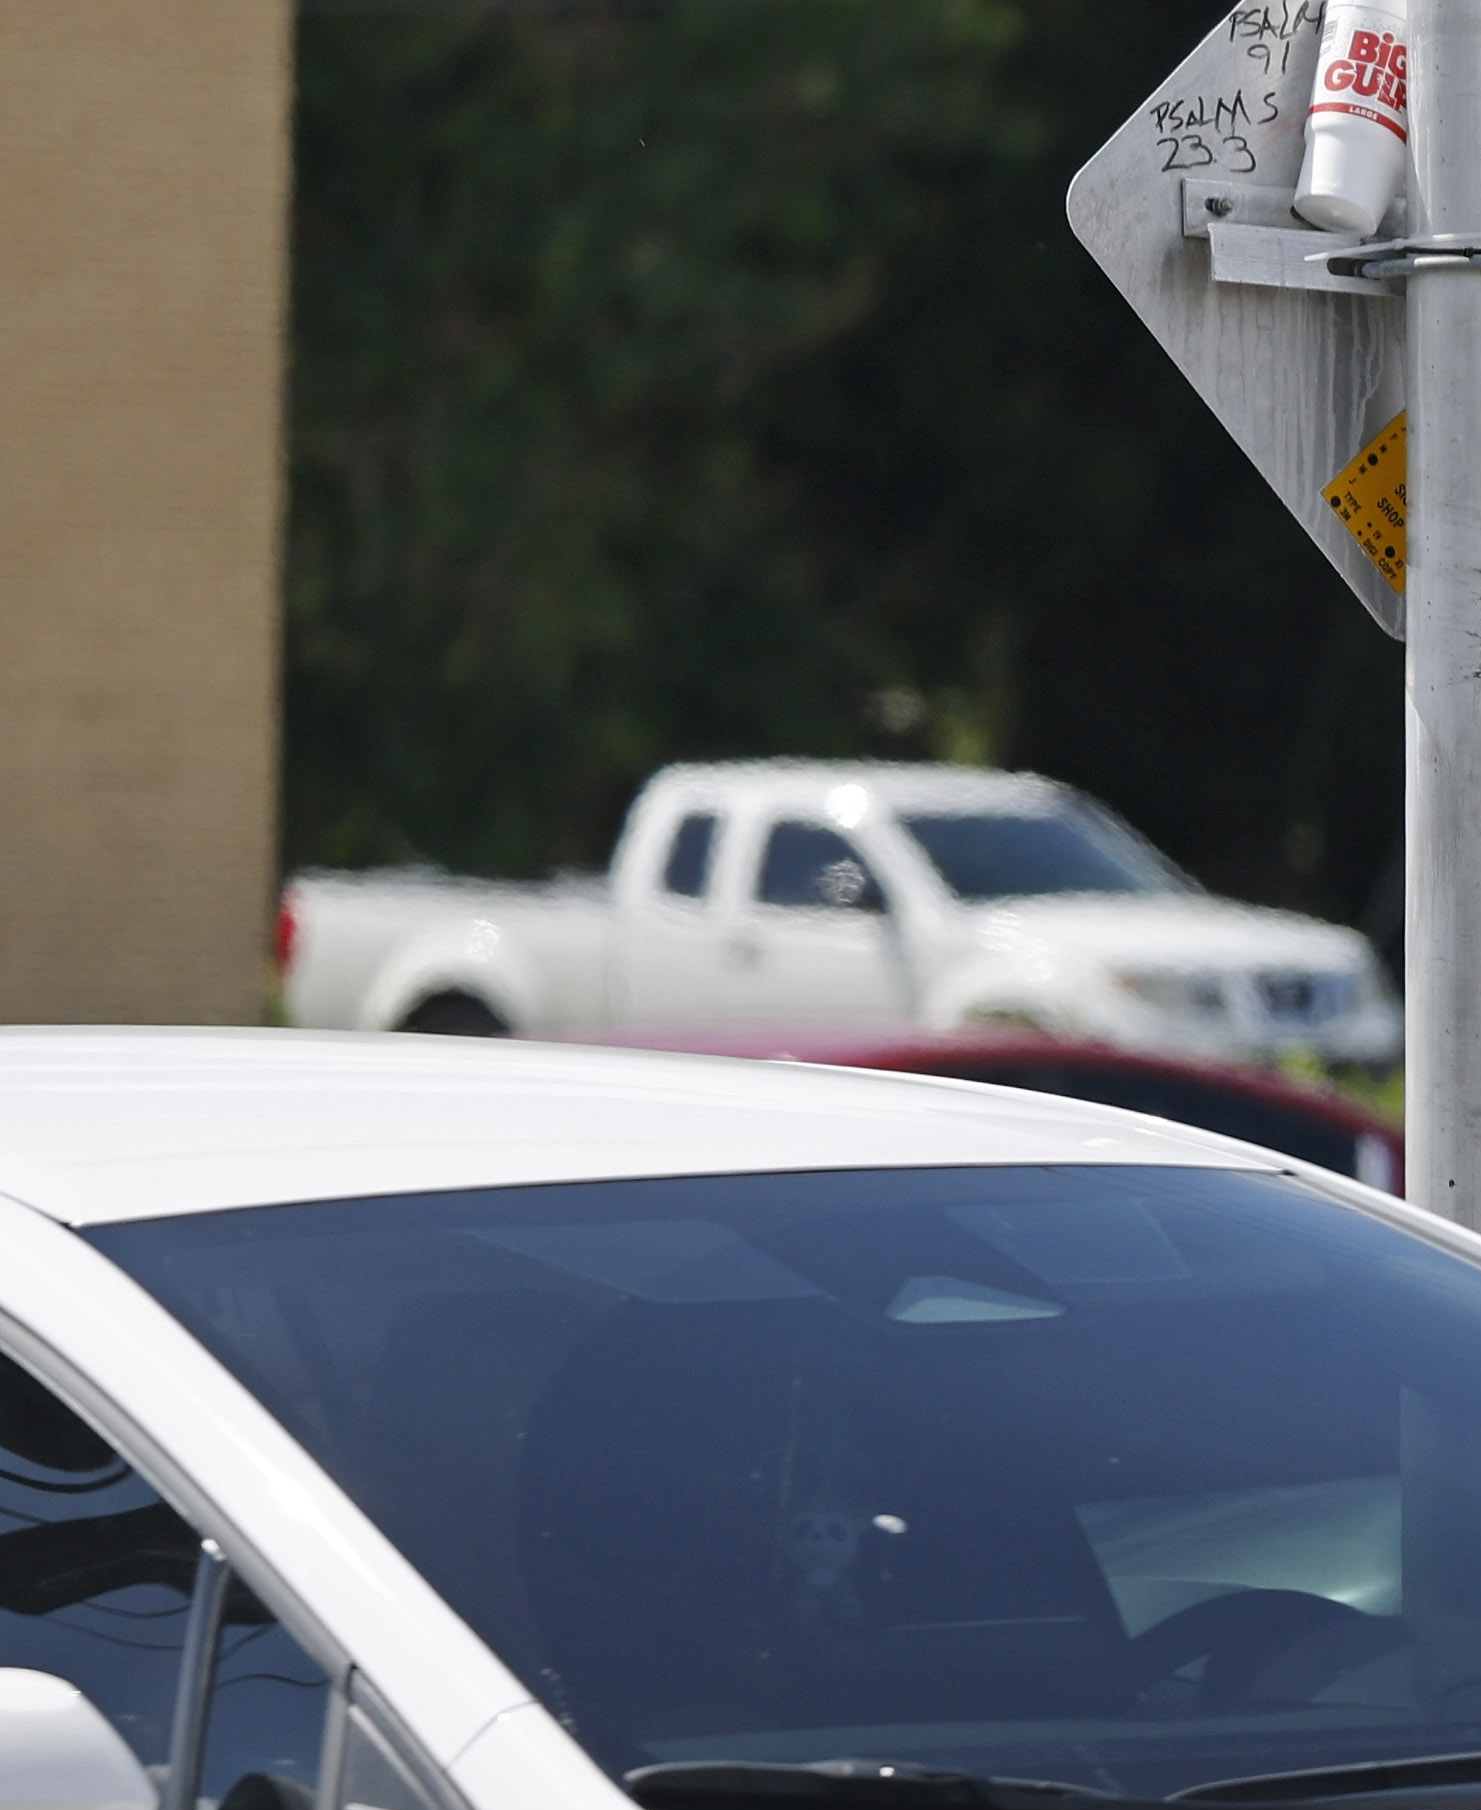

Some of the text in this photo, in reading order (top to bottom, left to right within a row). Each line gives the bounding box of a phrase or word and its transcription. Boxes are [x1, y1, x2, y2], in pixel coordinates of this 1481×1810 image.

[1246, 41, 1290, 75] 91
[1349, 106, 1378, 120] LARGE
[1344, 491, 1362, 513] TYPE
[1377, 498, 1405, 529] SHOP
[1378, 558, 1397, 579] COPY
